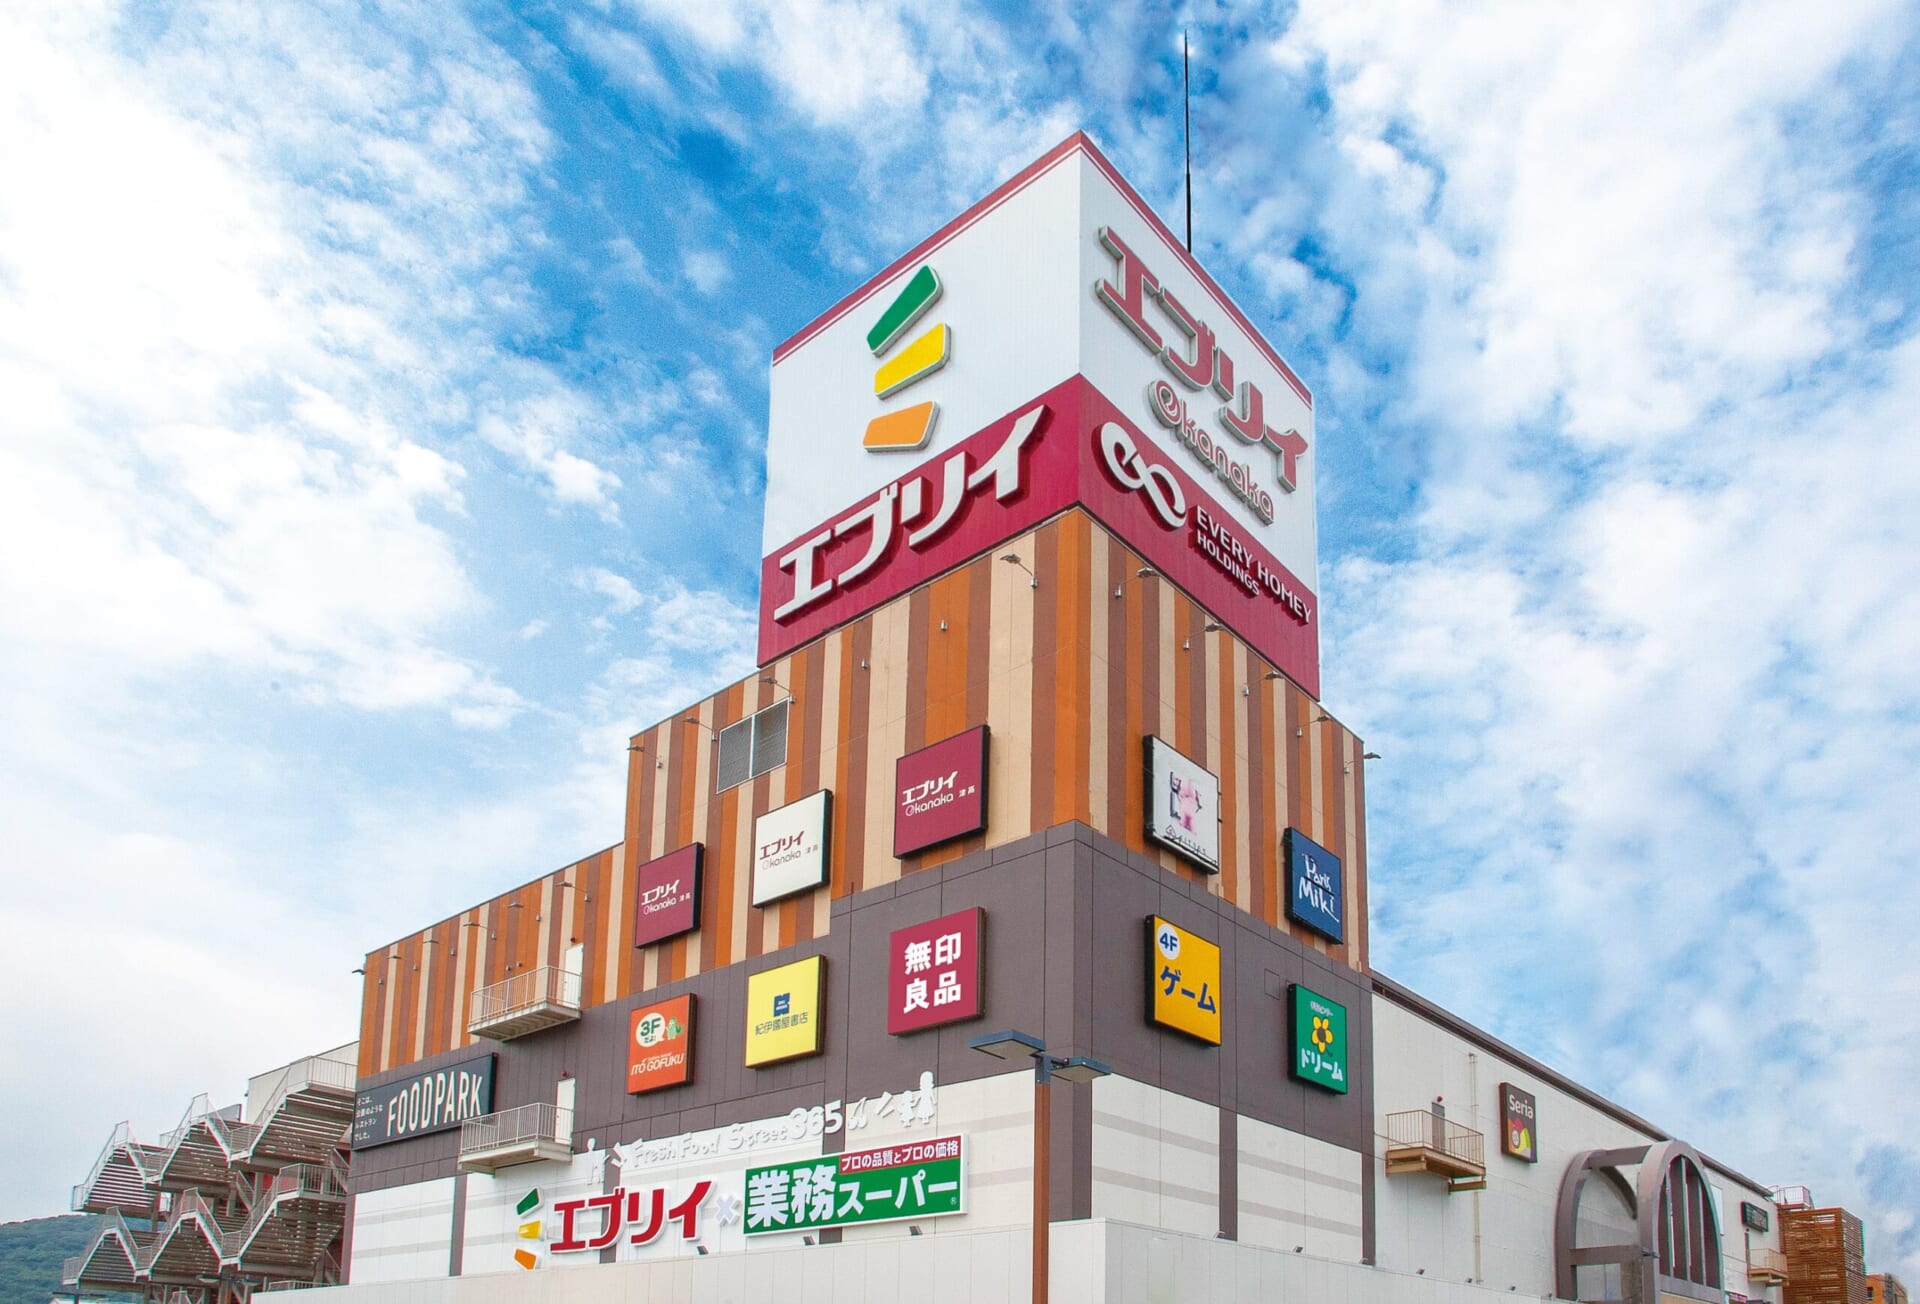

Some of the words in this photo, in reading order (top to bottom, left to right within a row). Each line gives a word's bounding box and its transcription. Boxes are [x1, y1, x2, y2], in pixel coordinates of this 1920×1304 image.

[1095, 226, 1308, 493] エブリイ
[774, 404, 1048, 622] エブリイ
[1196, 529, 1261, 597] HOLDINGS
[1196, 504, 1253, 571] EVERY
[1256, 561, 1312, 625] HOMEY
[902, 770, 958, 806] エブリイ
[759, 830, 805, 860] エブリイ
[641, 879, 680, 906] エブリイ
[1302, 853, 1332, 893] Paris
[1299, 876, 1340, 924] Miki
[904, 931, 962, 976] 無印
[1160, 932, 1178, 952] 4F
[903, 970, 962, 1014] 良品
[1160, 965, 1217, 1015] ゲーム
[640, 1017, 662, 1037] 3F
[646, 1053, 685, 1073] GOFUKU
[1301, 1047, 1344, 1082] ドリーム
[1509, 1094, 1534, 1119] Seria
[634, 1138, 677, 1168] Fresh
[681, 1132, 721, 1158] Food
[727, 1122, 787, 1150] Street
[787, 1100, 844, 1139] 365
[841, 1140, 960, 1172] プロの品質とプロの価格
[550, 1180, 712, 1253] エブリイ
[747, 1164, 958, 1229] 業務スーパー
